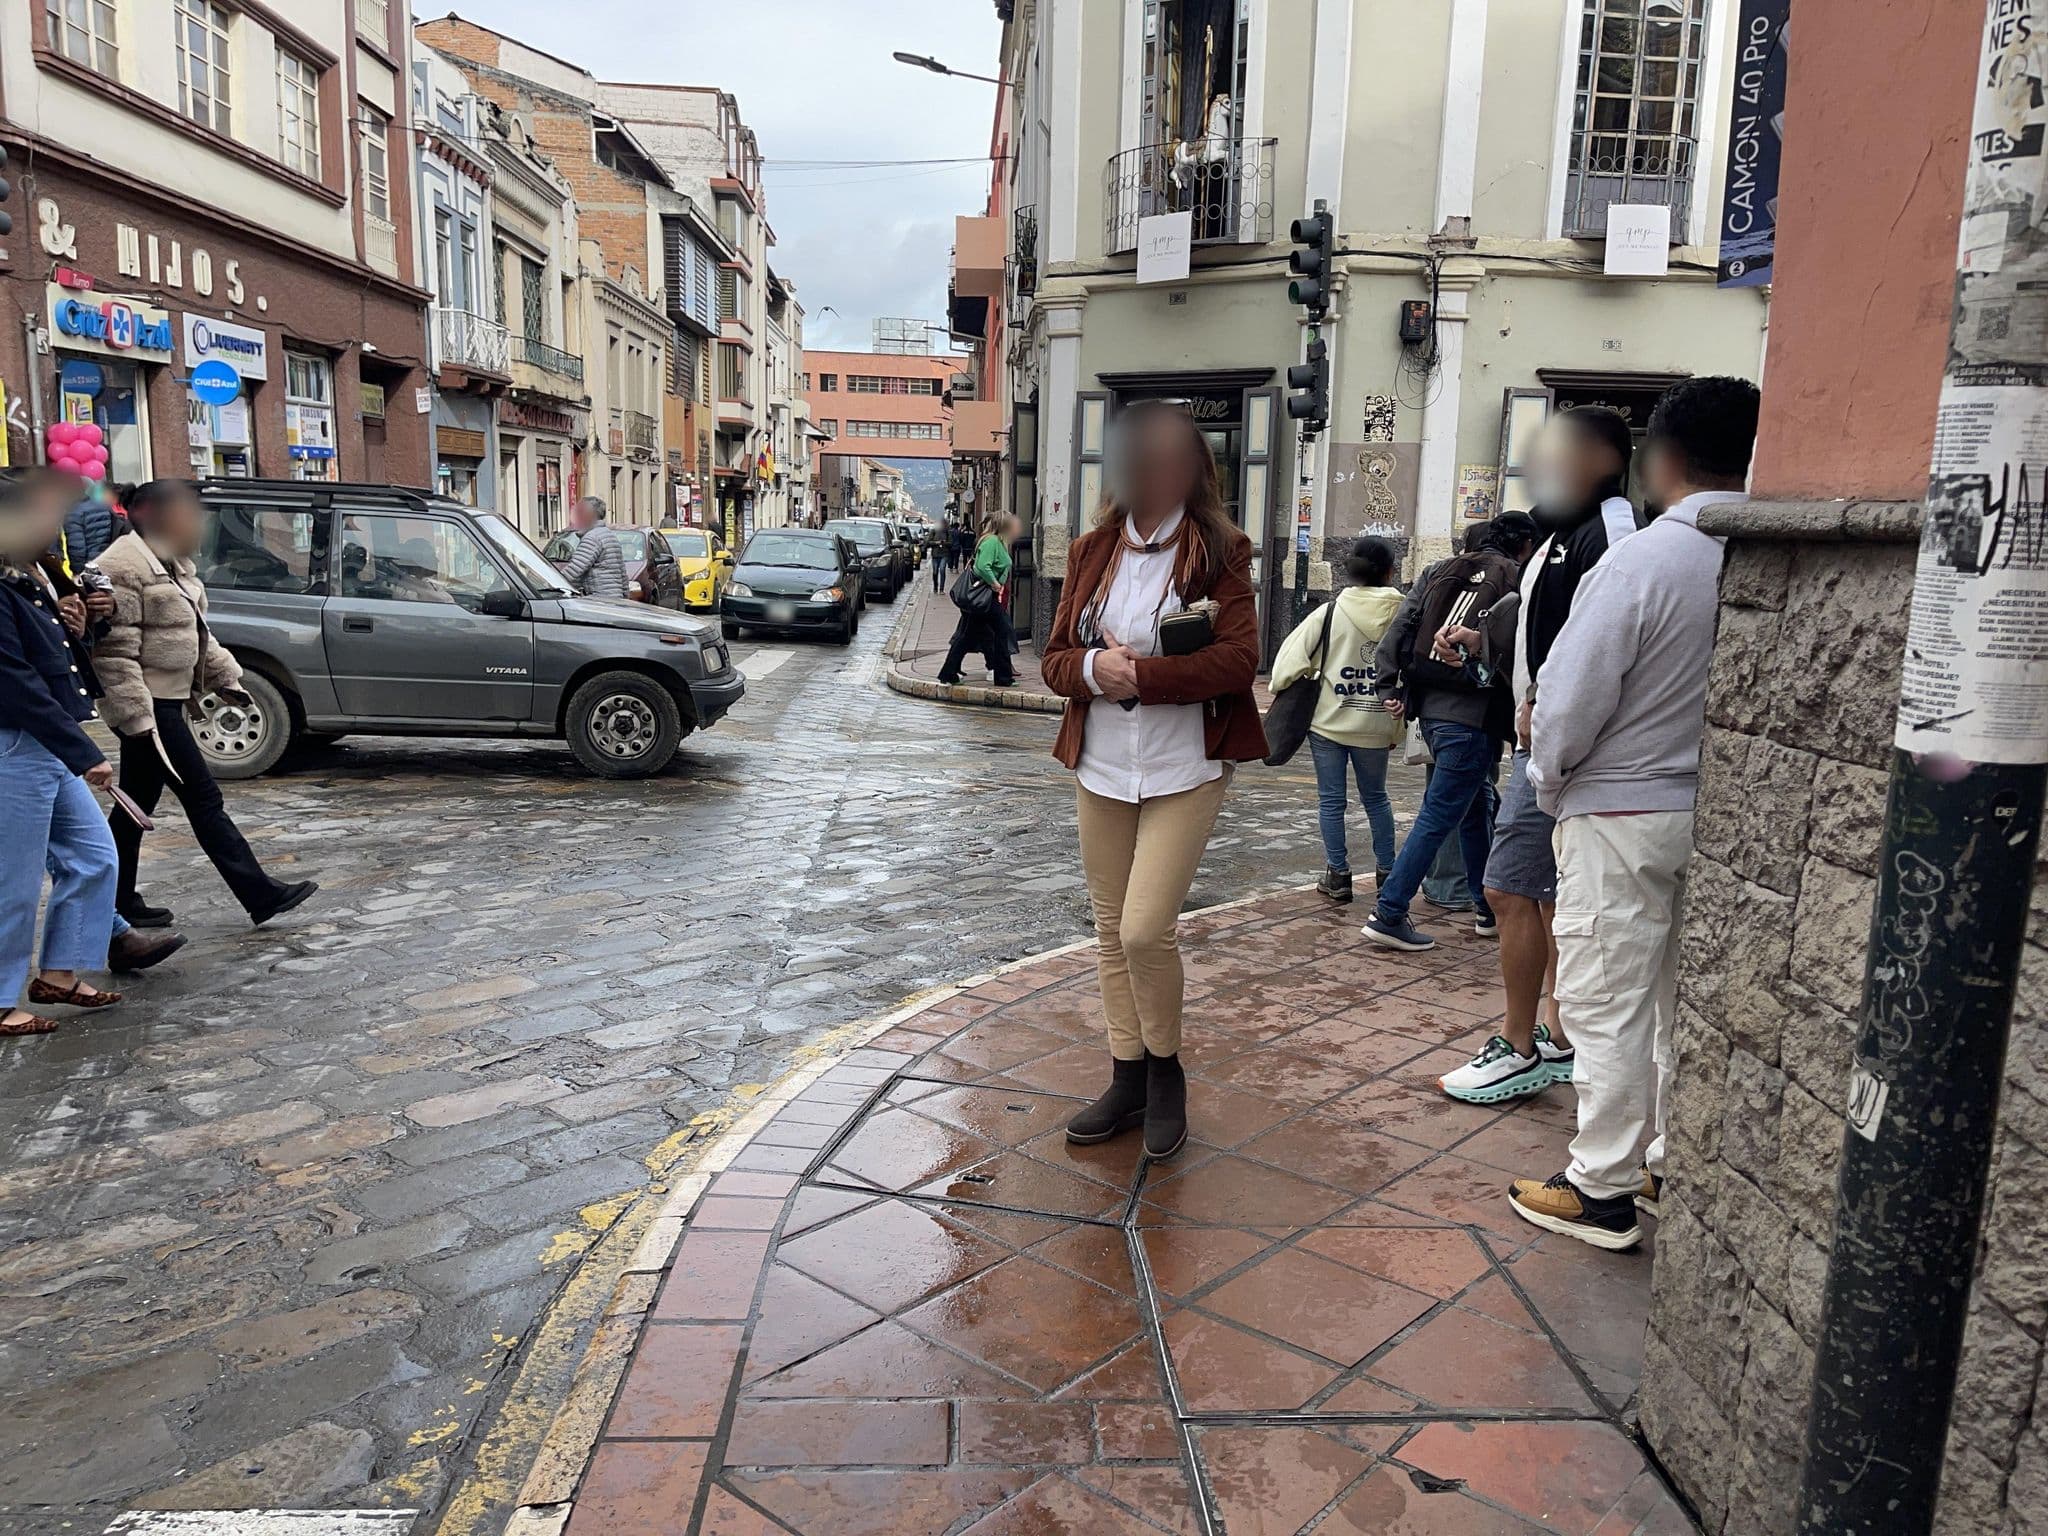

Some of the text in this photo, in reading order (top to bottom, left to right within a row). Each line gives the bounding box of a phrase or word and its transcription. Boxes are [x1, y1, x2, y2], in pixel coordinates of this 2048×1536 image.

[1729, 16, 1769, 233] CAMON 40 Pro
[38, 198, 77, 260] &
[219, 380, 237, 388] Azul
[485, 666, 528, 675] VITARA
